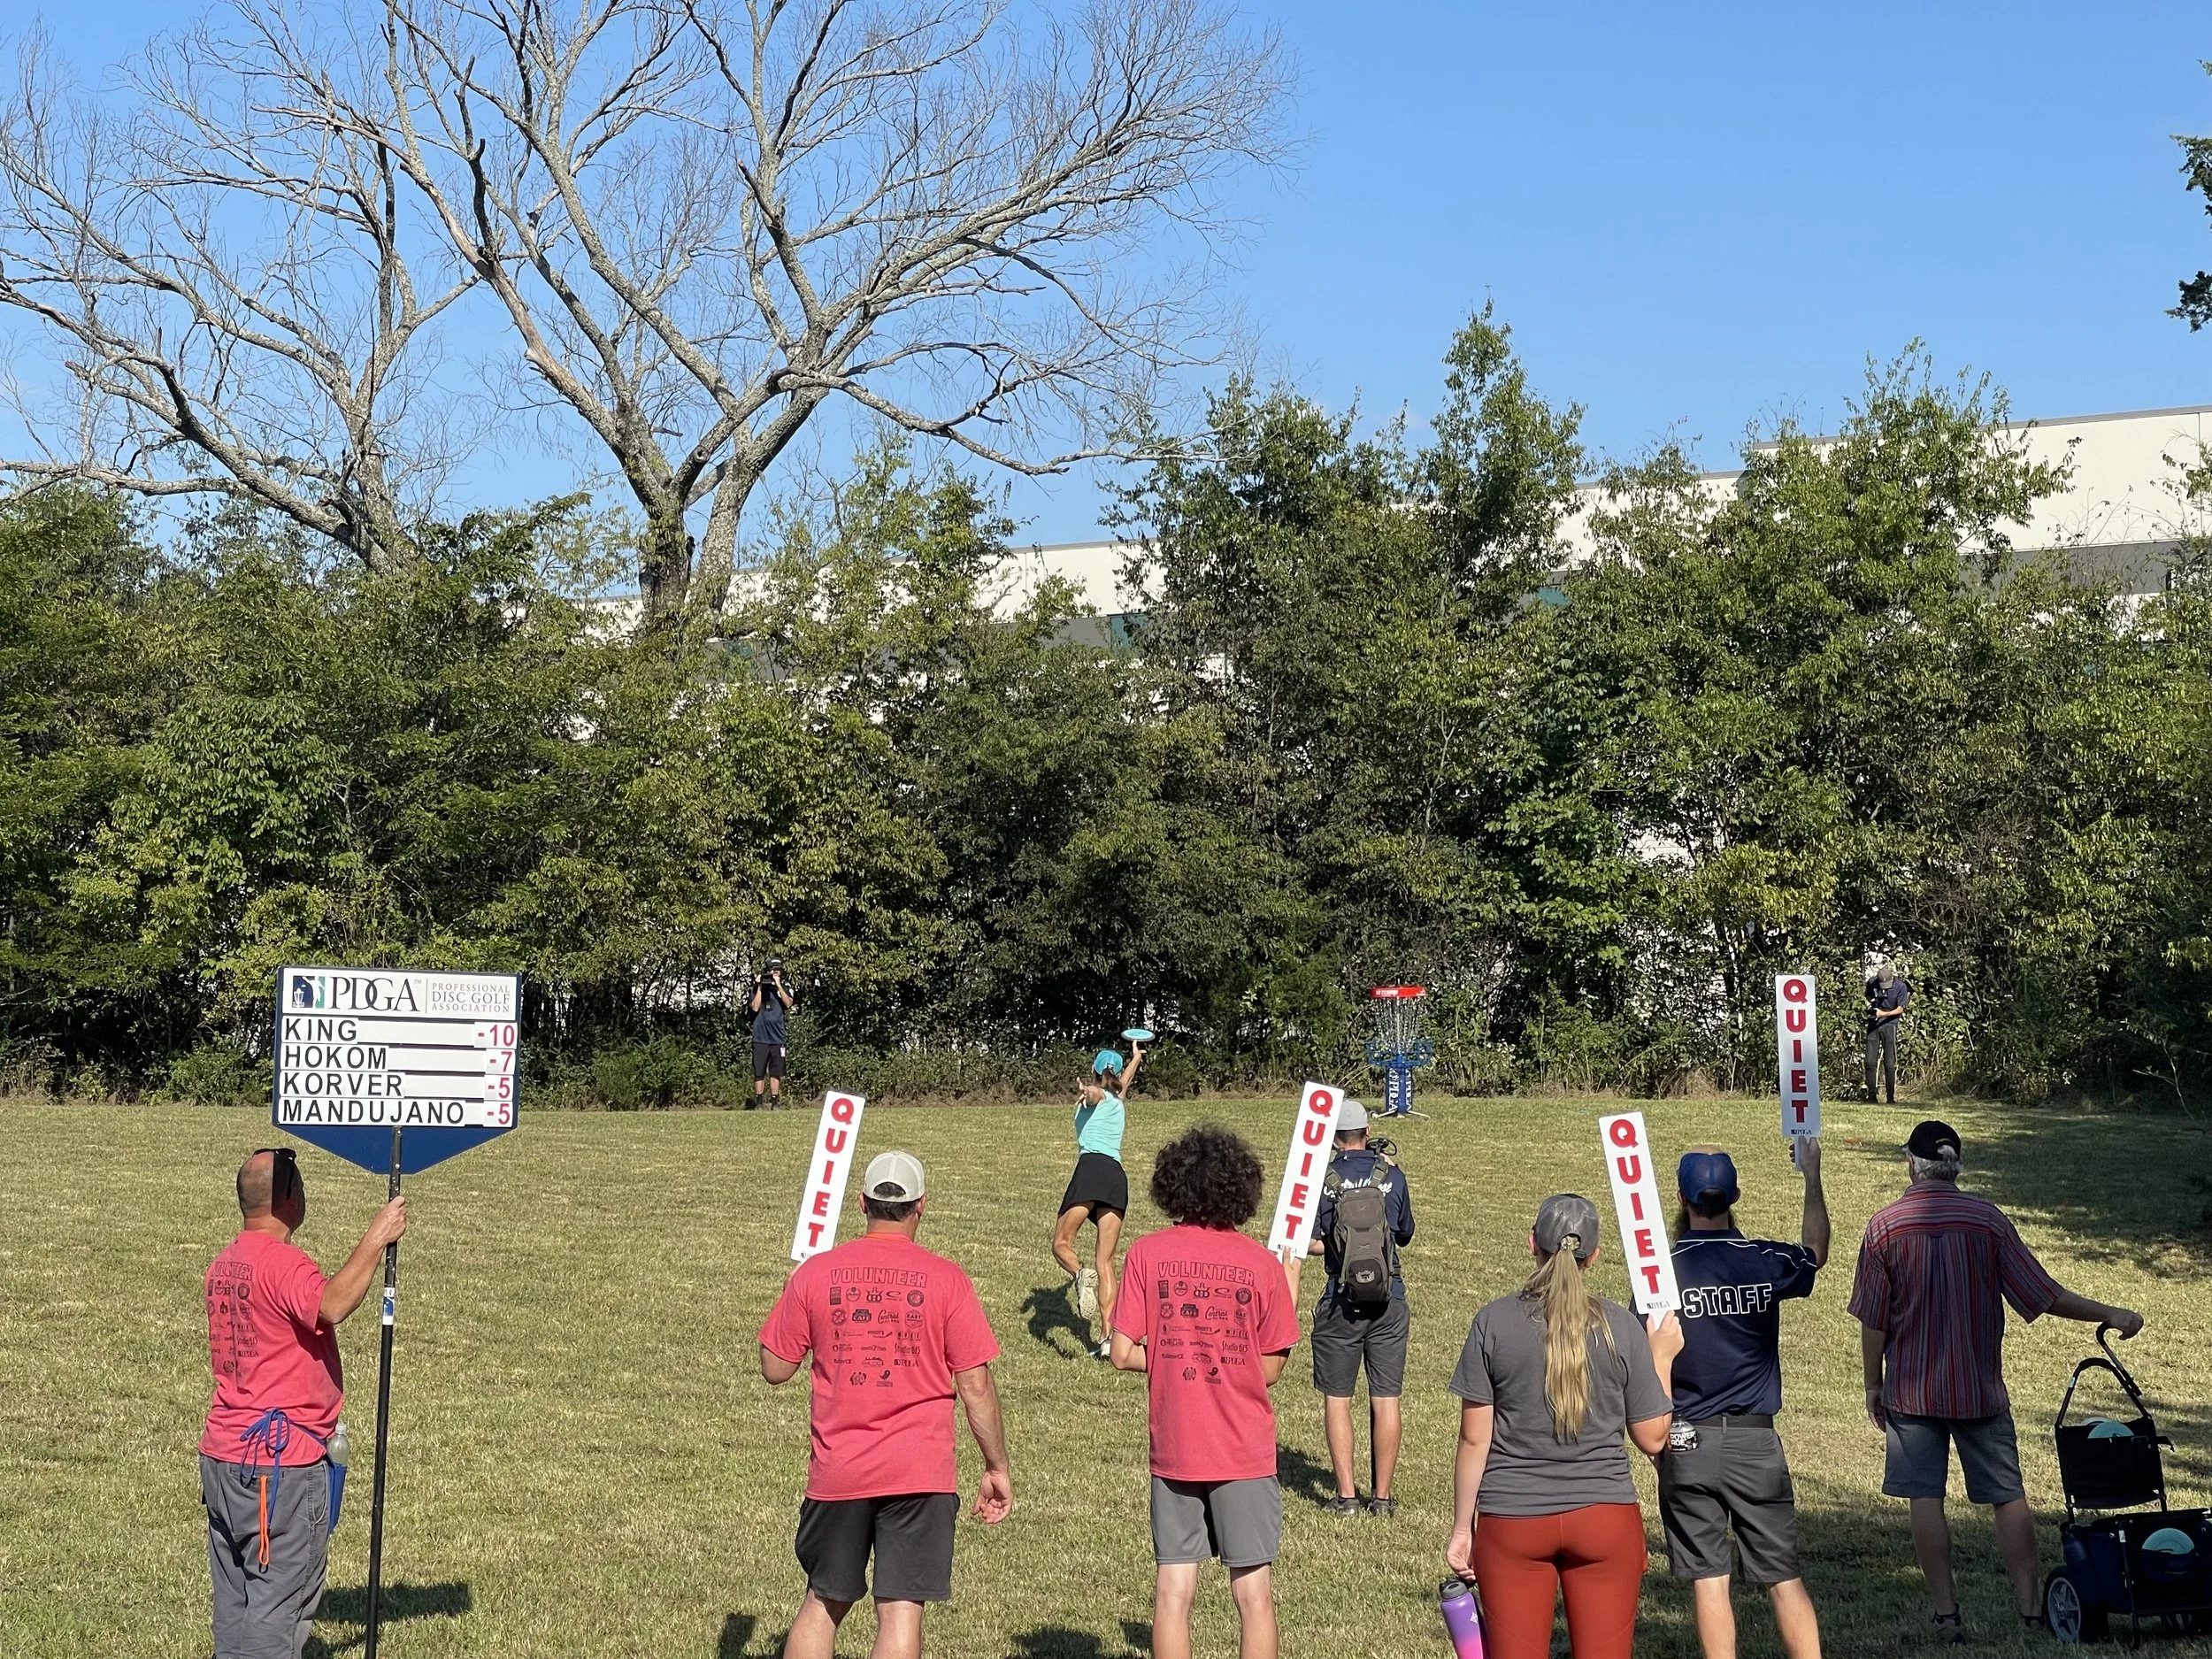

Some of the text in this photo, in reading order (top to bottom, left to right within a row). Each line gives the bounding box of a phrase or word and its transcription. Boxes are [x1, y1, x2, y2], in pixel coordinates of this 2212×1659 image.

[328, 976, 420, 1012] PDGA
[432, 982, 511, 993] PROFESSIONAL
[432, 991, 511, 1004] DISC GOLF
[431, 1002, 510, 1013] ASSOCIATION
[284, 1018, 516, 1048] KING -10
[284, 1045, 513, 1073] HOKOM -7
[1782, 979, 1809, 1124] QUIET
[283, 1071, 511, 1100] KORVER -5
[282, 1099, 511, 1125] MANDUJANO -5
[808, 1097, 855, 1248] QUIET
[1286, 1089, 1333, 1240] QUIET
[1609, 1118, 1660, 1294] QUIET
[831, 1267, 928, 1288] VOLUNTEER
[1157, 1260, 1255, 1287] VOLUNTEER
[1681, 1283, 1772, 1318] STAFF
[1670, 1430, 1696, 1441] POWER
